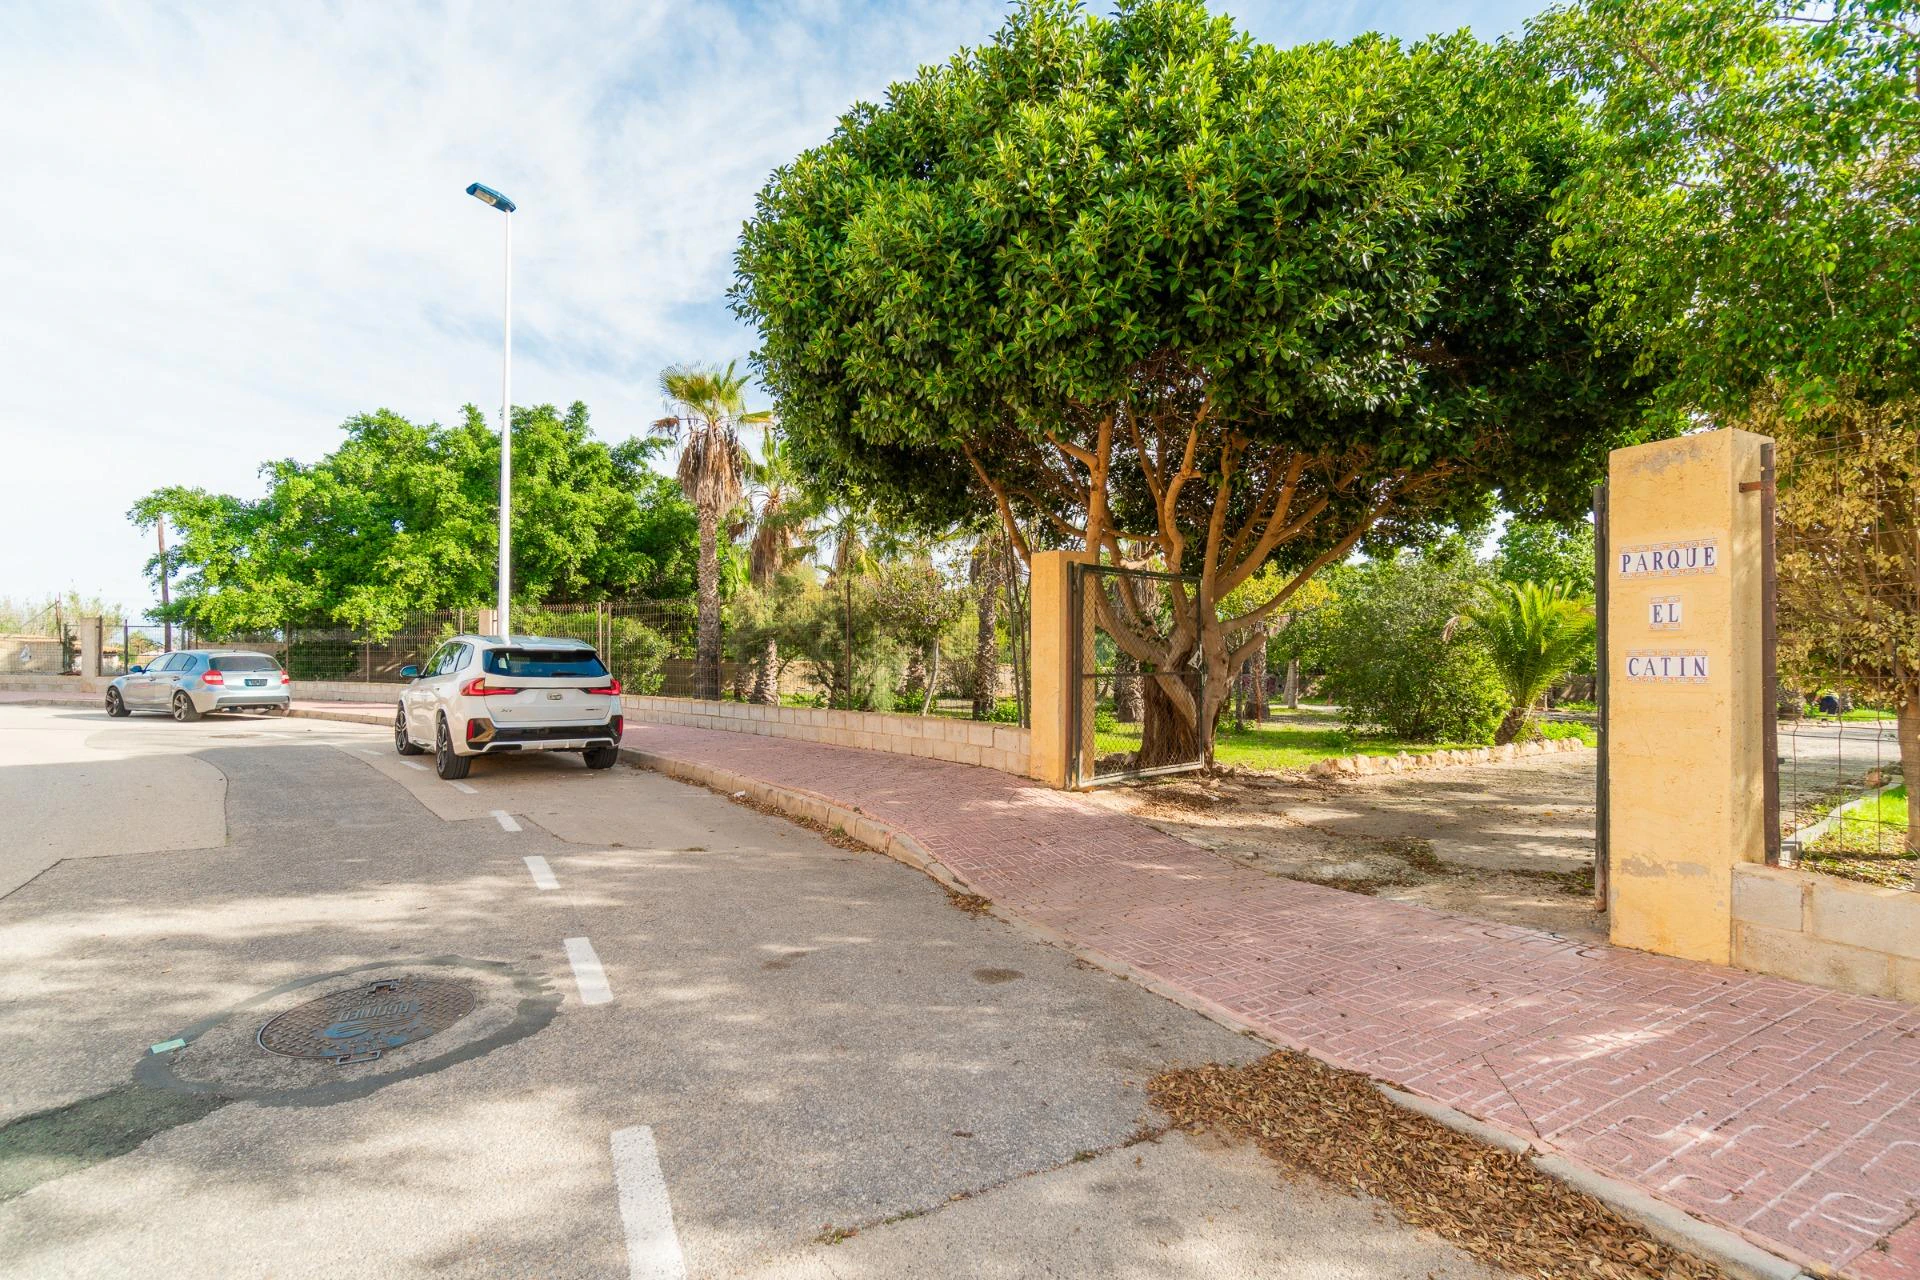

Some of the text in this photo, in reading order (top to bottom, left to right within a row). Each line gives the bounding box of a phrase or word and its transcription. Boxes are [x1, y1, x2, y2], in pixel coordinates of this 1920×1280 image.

[1622, 546, 1715, 573] PARQUE
[1653, 603, 1679, 624] EL
[1628, 656, 1706, 677] CATIN
